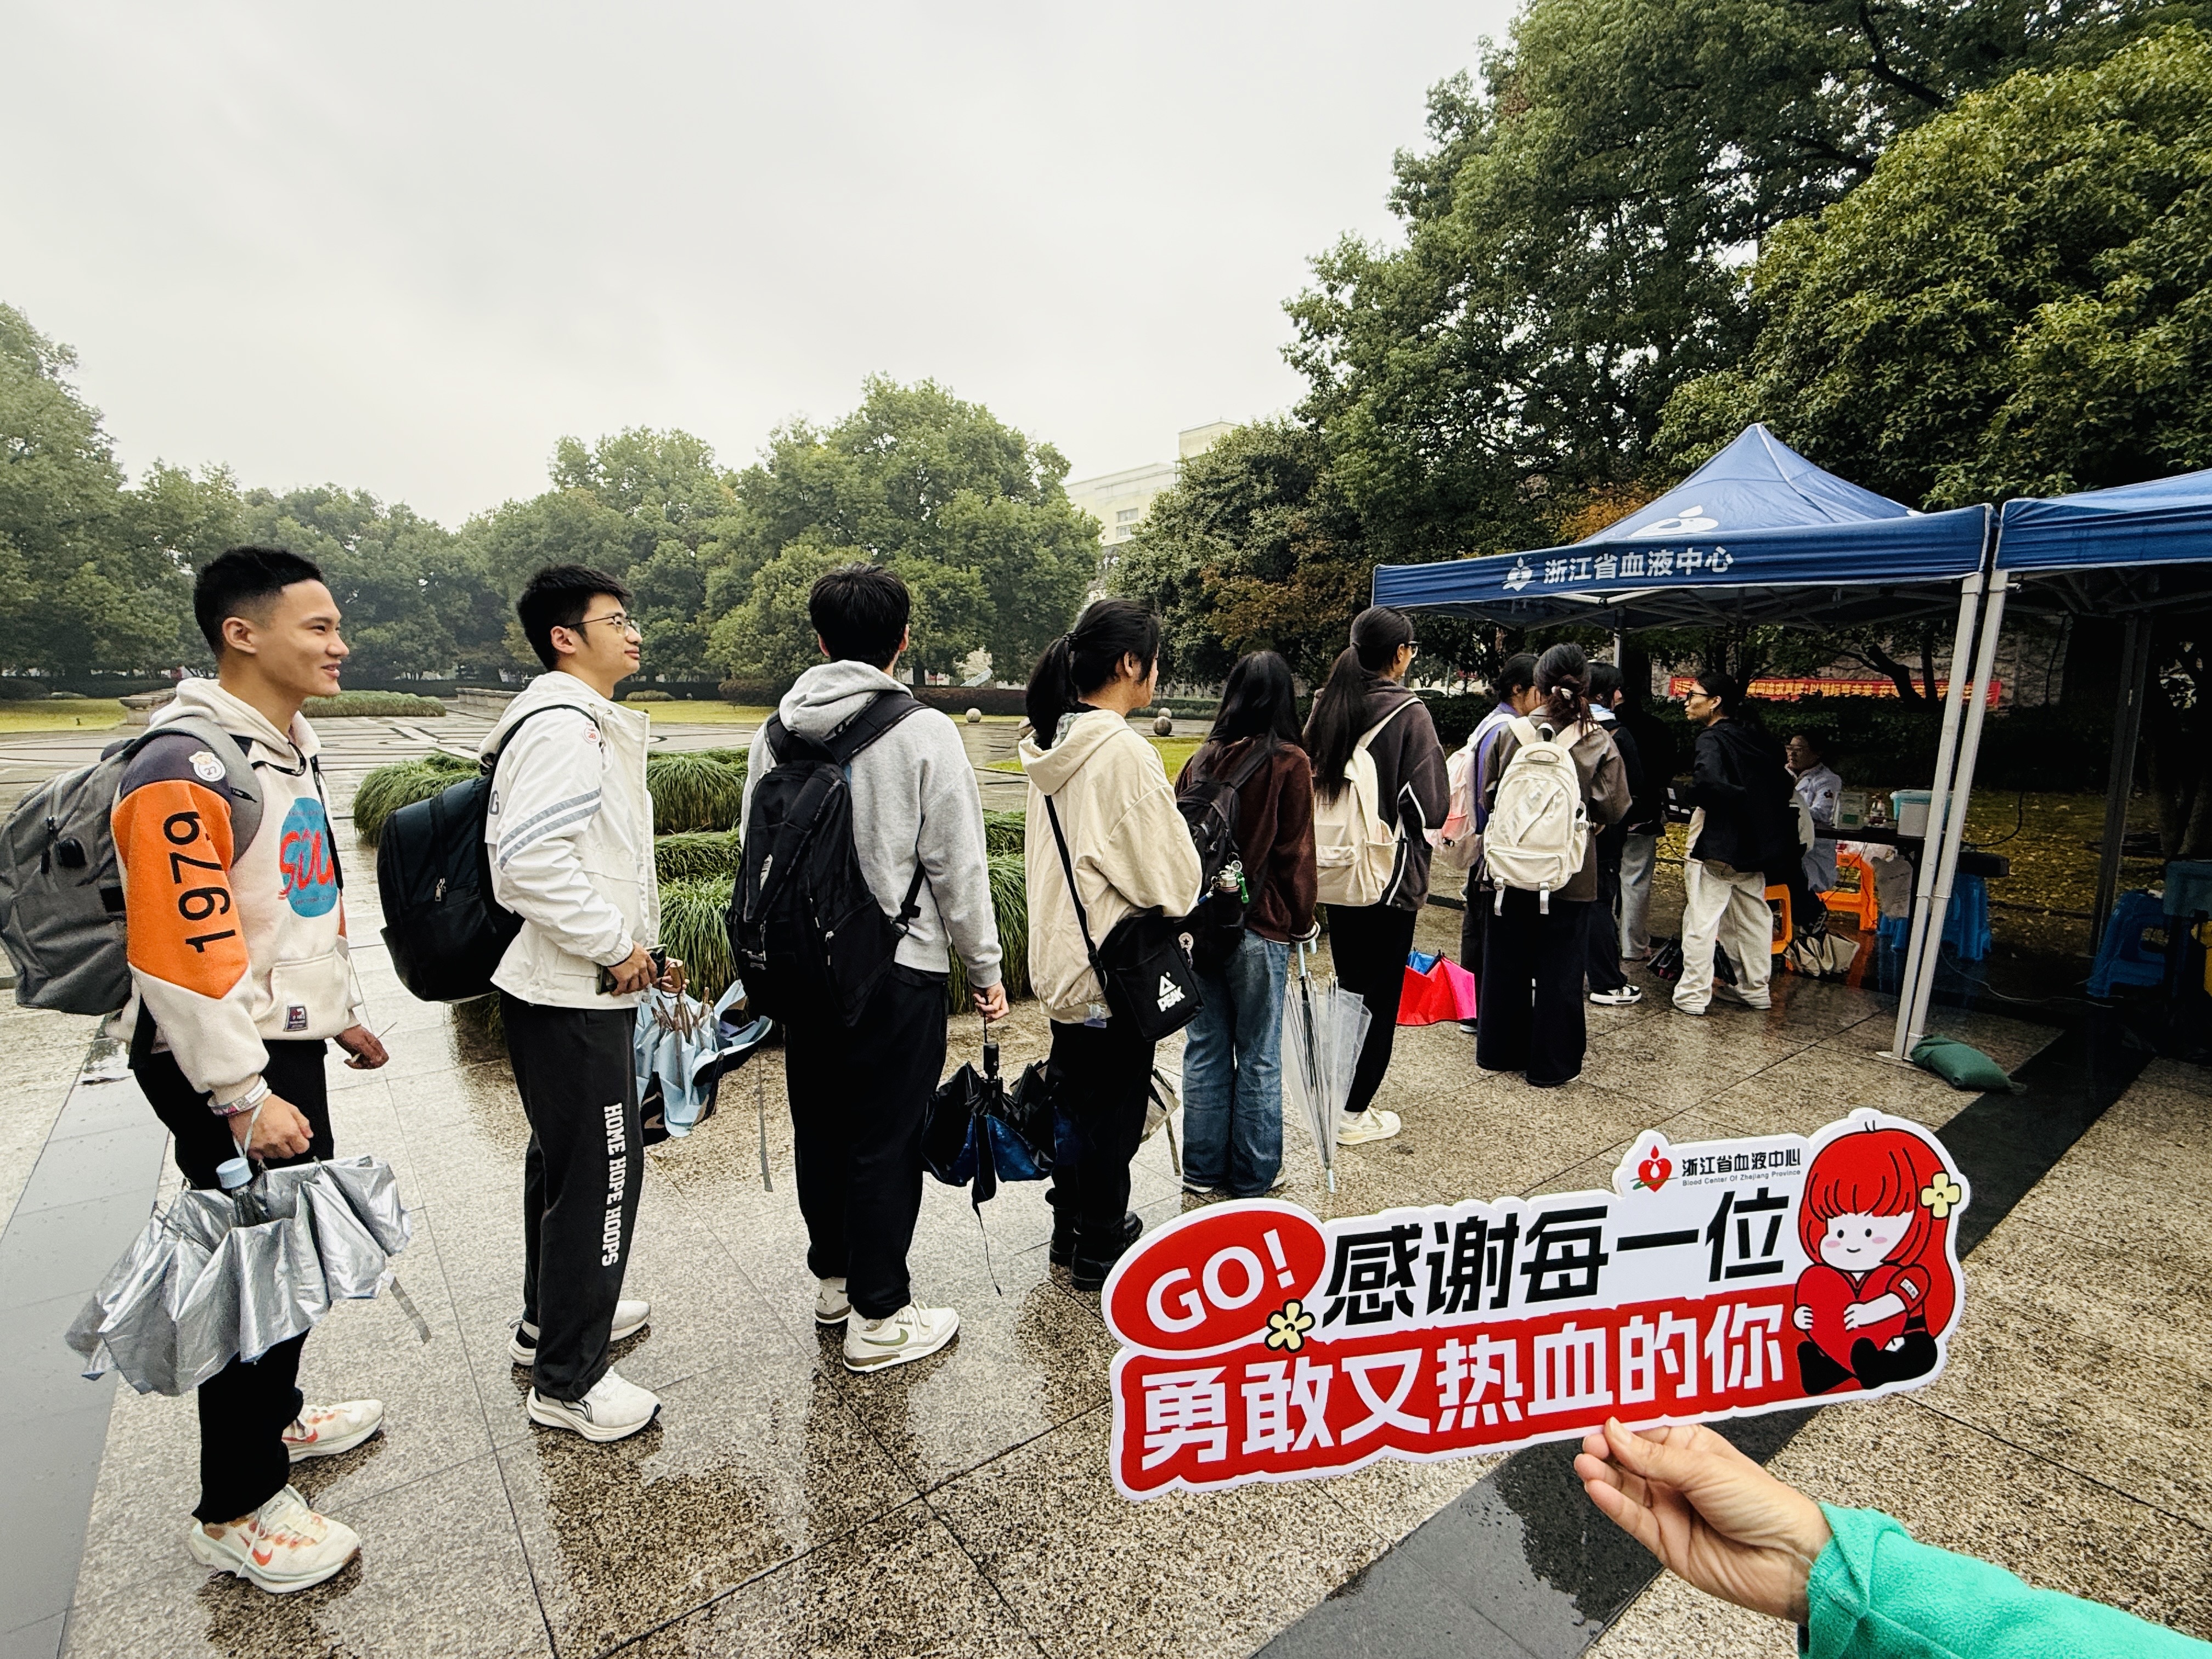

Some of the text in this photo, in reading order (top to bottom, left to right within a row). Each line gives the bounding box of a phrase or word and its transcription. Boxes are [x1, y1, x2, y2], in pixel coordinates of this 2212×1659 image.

[1543, 546, 1734, 584] 浙江省血液中心
[163, 811, 236, 953] 1979
[1157, 986, 1186, 1012] PEAK
[602, 1103, 627, 1267] HOME HOPE HOOPS
[1681, 1148, 1801, 1177] 浙江省血液中心
[1704, 1176, 1727, 1184] Center
[1740, 1172, 1769, 1181] Zhejiang
[1146, 1228, 1296, 1333] GO!
[1322, 1186, 1790, 1328] 感谢每一位
[1142, 1301, 1785, 1471] 勇敢又热血的你
